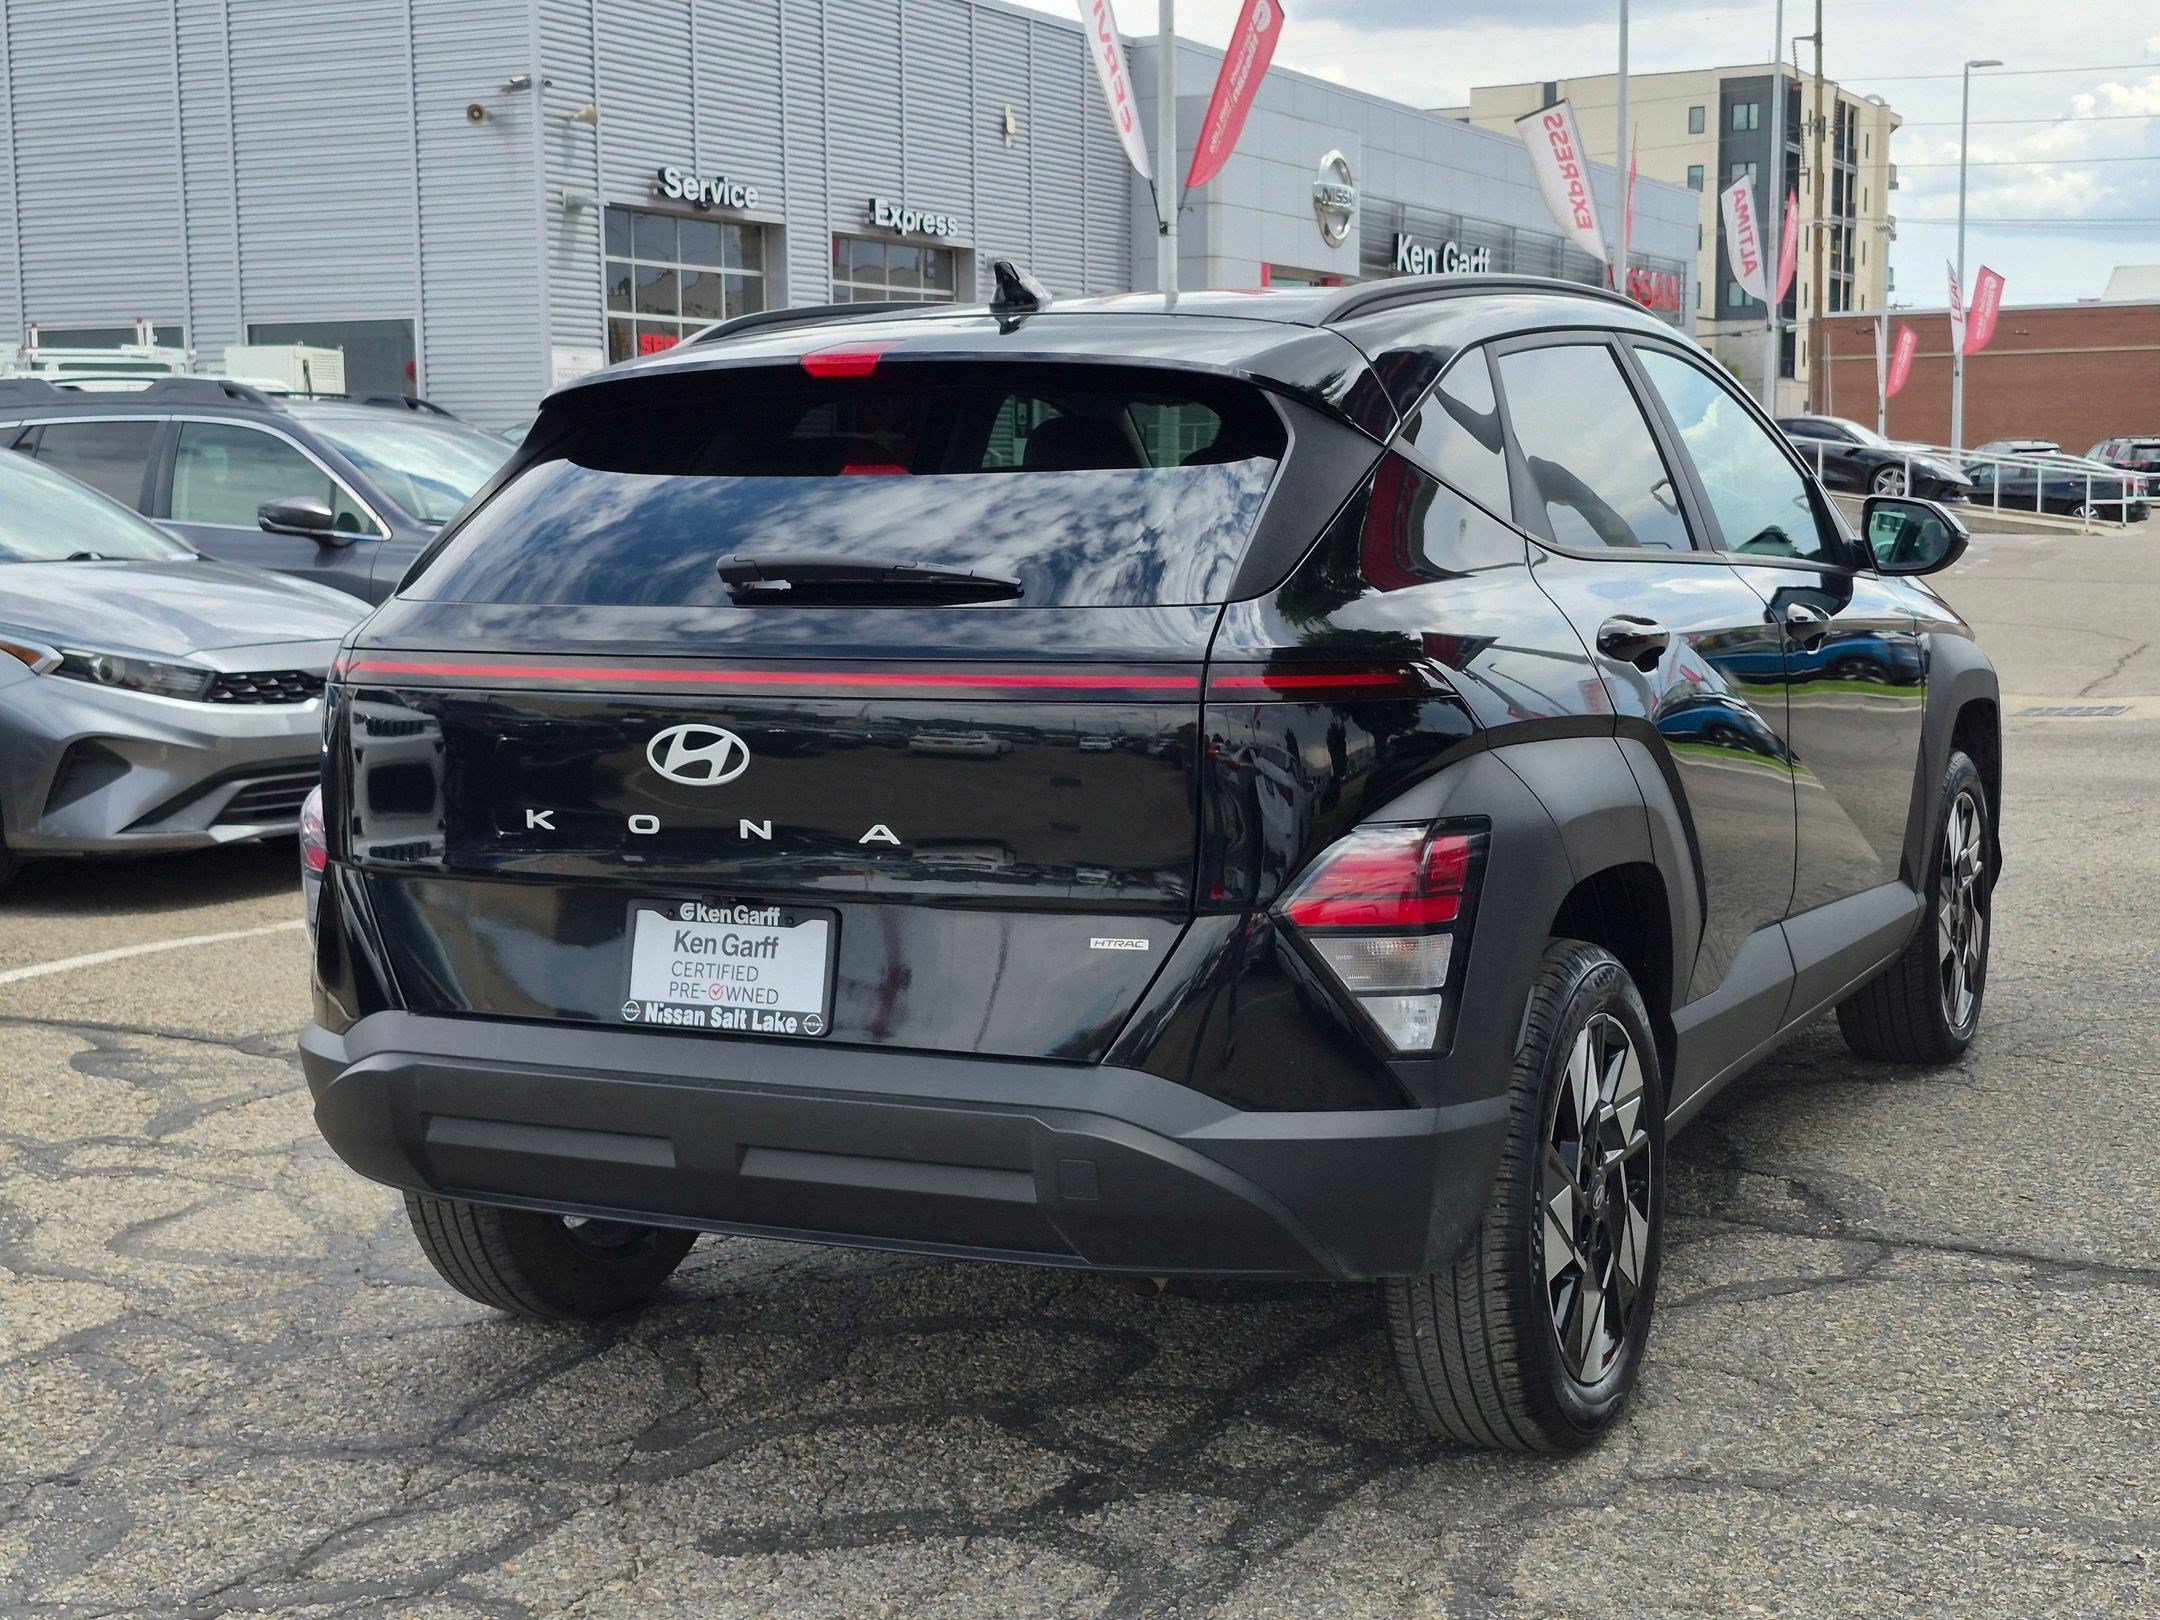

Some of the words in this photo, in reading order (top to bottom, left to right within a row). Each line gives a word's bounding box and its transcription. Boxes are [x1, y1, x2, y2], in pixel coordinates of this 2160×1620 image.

[664, 166, 759, 209] Service
[875, 198, 958, 236] Express
[1397, 232, 1437, 275] Ken
[1443, 241, 1491, 274] Garff
[525, 809, 901, 845] KONA
[697, 903, 732, 924] Ken
[734, 905, 781, 926] Garff
[673, 929, 717, 955] Ken
[721, 933, 780, 960] Garff
[1094, 939, 1144, 949] HTRAC
[671, 960, 759, 982] CERTIFIED
[645, 1002, 706, 1027] Nissan
[710, 1007, 747, 1030] Salt
[752, 1010, 798, 1034] Lake
